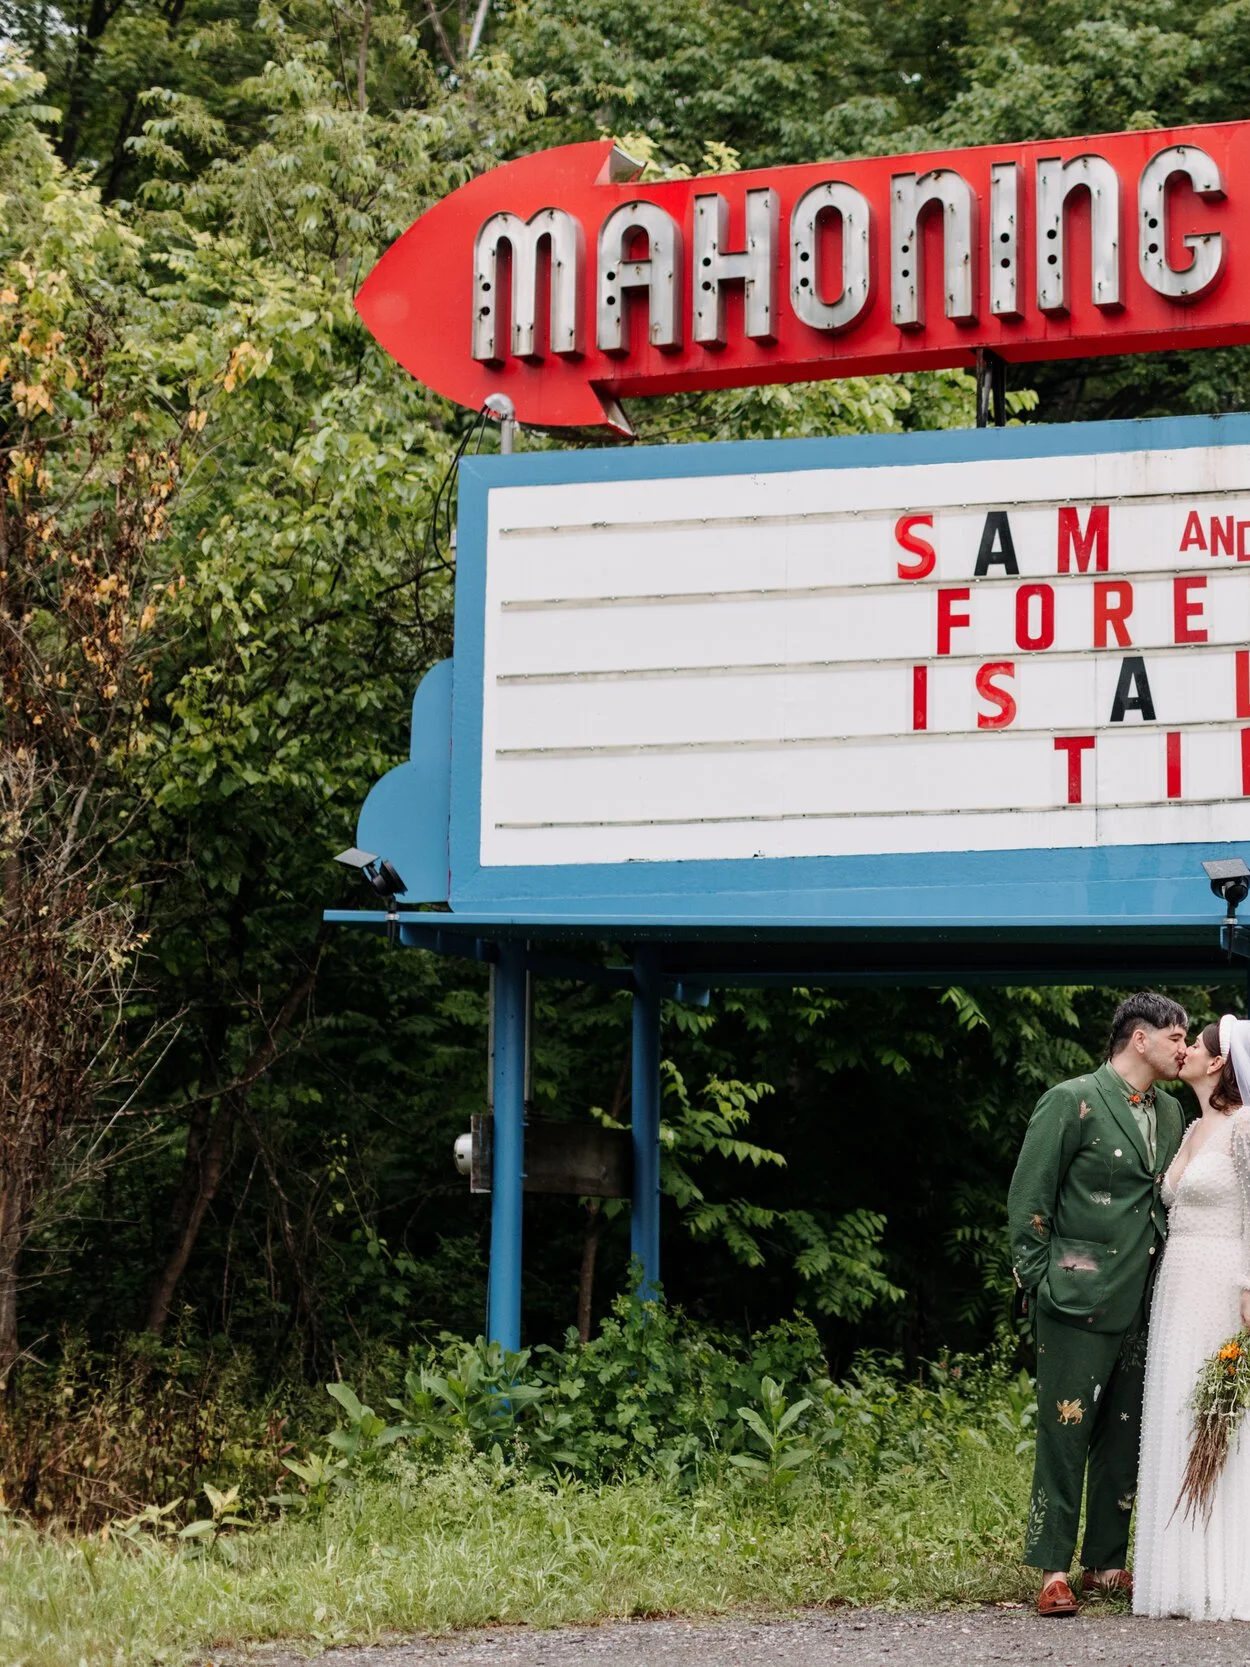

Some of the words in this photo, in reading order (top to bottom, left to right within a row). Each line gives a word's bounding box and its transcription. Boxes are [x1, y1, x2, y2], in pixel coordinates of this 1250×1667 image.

[472, 145, 1227, 368] MAHONING
[895, 505, 1109, 579] SAM
[912, 661, 1016, 730] IS
[1110, 656, 1156, 722] A
